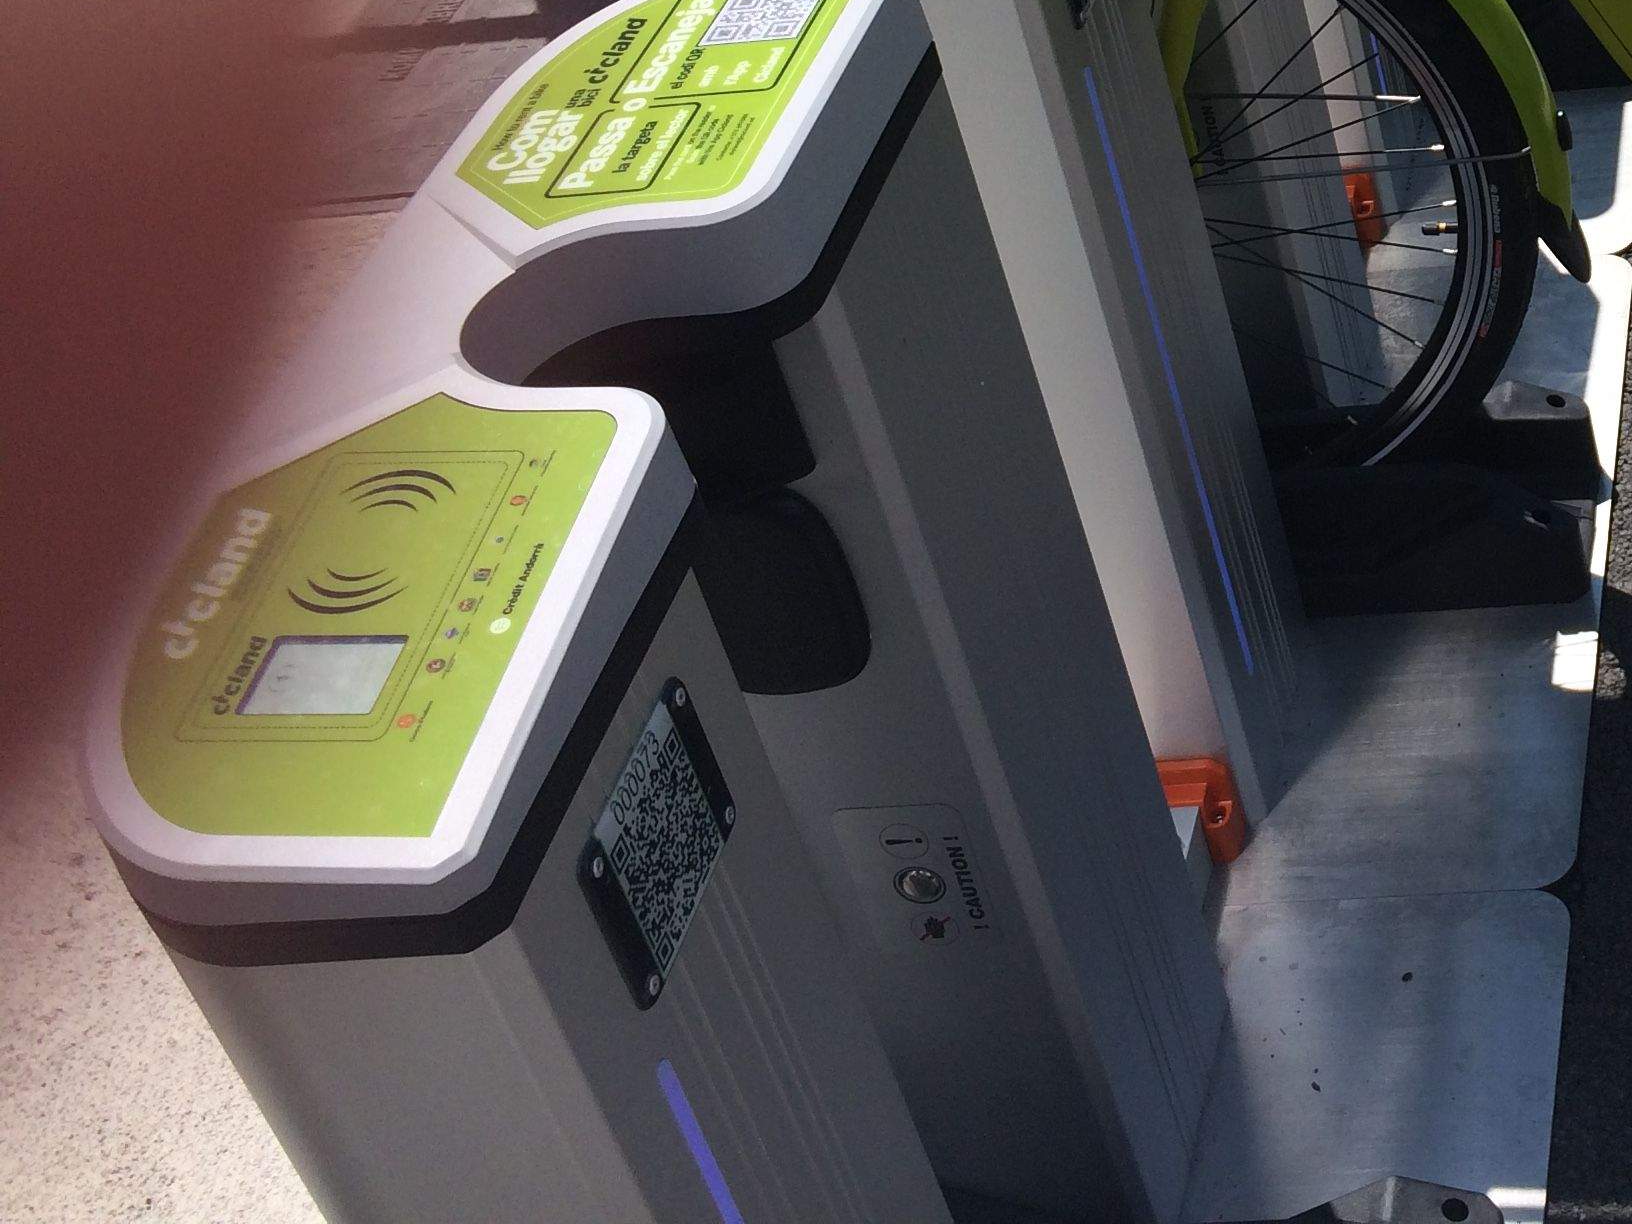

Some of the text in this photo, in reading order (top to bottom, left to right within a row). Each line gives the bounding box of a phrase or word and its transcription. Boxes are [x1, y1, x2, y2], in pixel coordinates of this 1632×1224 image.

[584, 18, 648, 84] cicland
[565, 88, 586, 108] una
[577, 88, 602, 108] bici
[487, 109, 560, 171] Com
[503, 110, 584, 185] llogar
[557, 115, 636, 189] Passa
[622, 97, 648, 112] o
[625, 120, 658, 162] targeta
[610, 731, 662, 828] 000073
[946, 846, 985, 920] CAUTION
